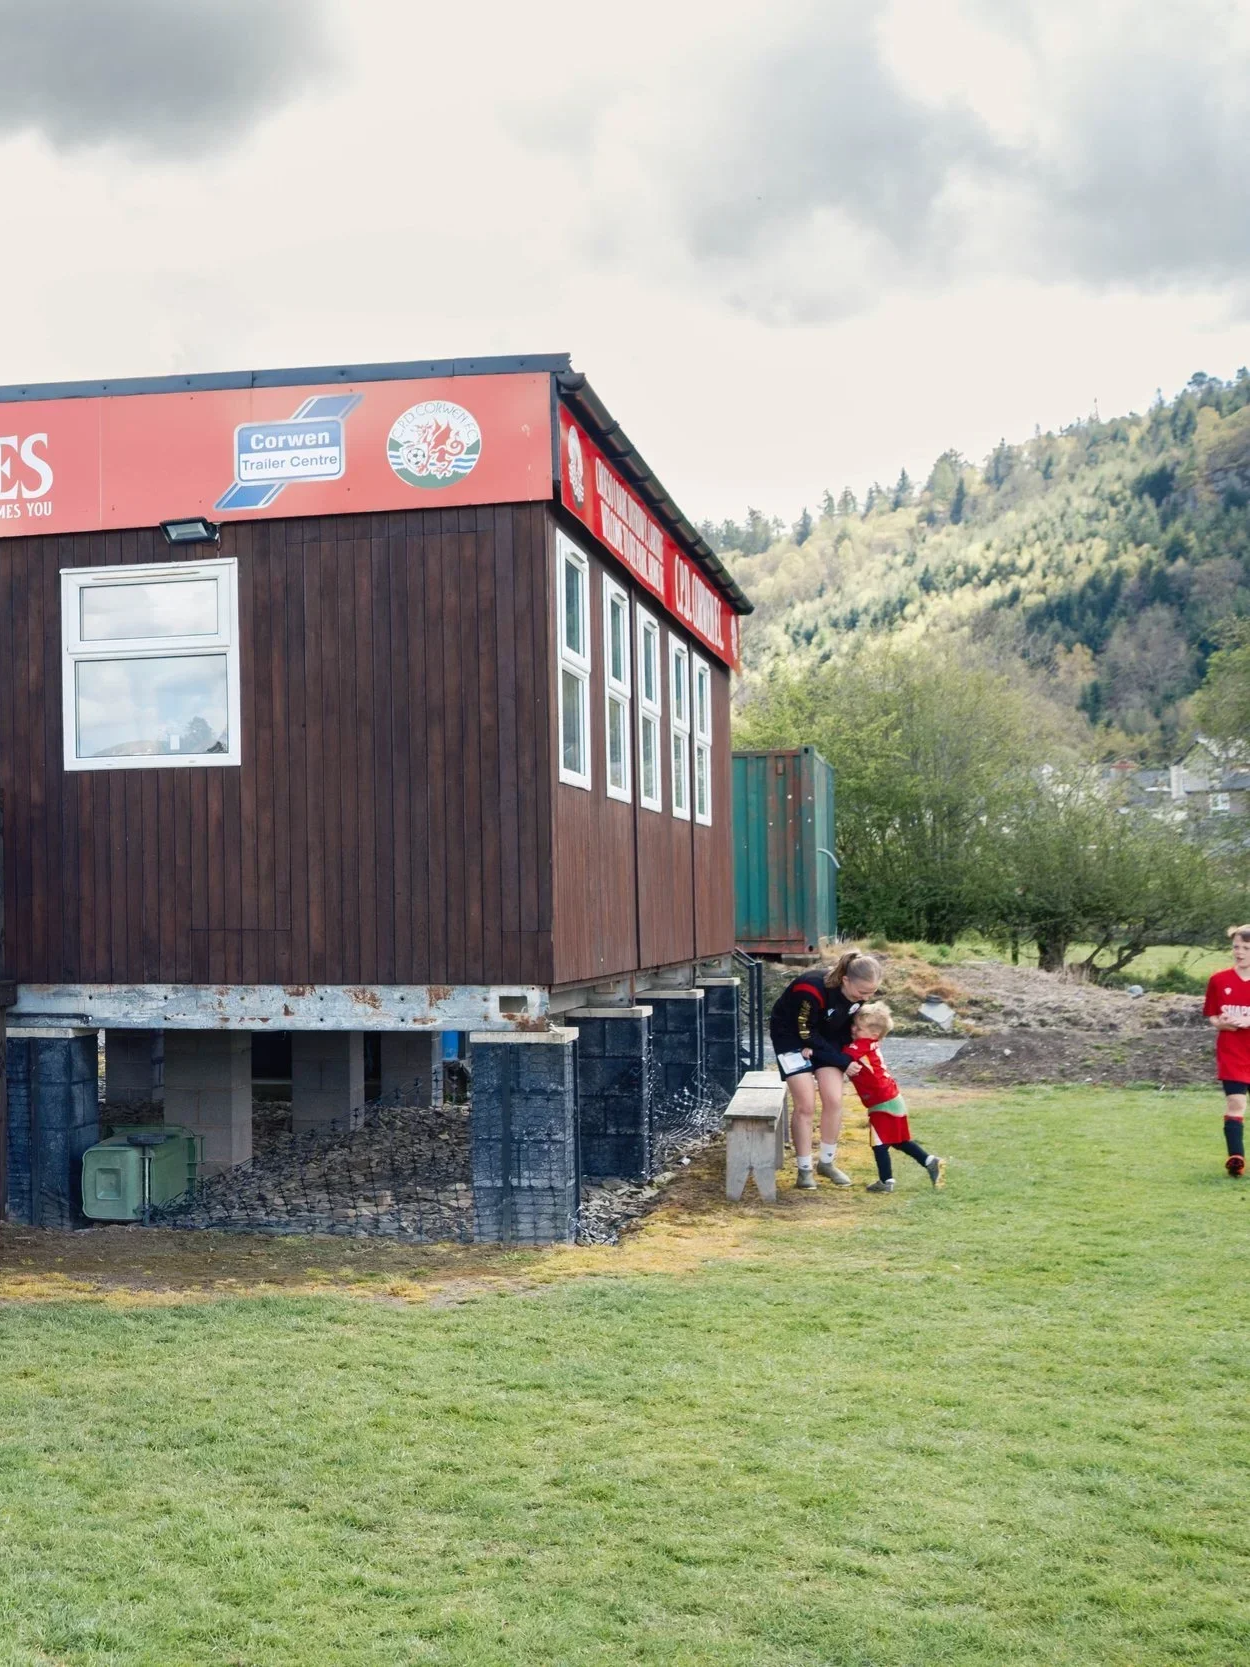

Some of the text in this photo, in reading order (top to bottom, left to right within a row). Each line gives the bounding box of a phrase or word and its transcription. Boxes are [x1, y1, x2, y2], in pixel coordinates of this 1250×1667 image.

[415, 402, 469, 424] CORWEN
[250, 431, 330, 450] Corwen
[242, 455, 338, 471] Trailer Centre
[26, 501, 53, 517] YOU
